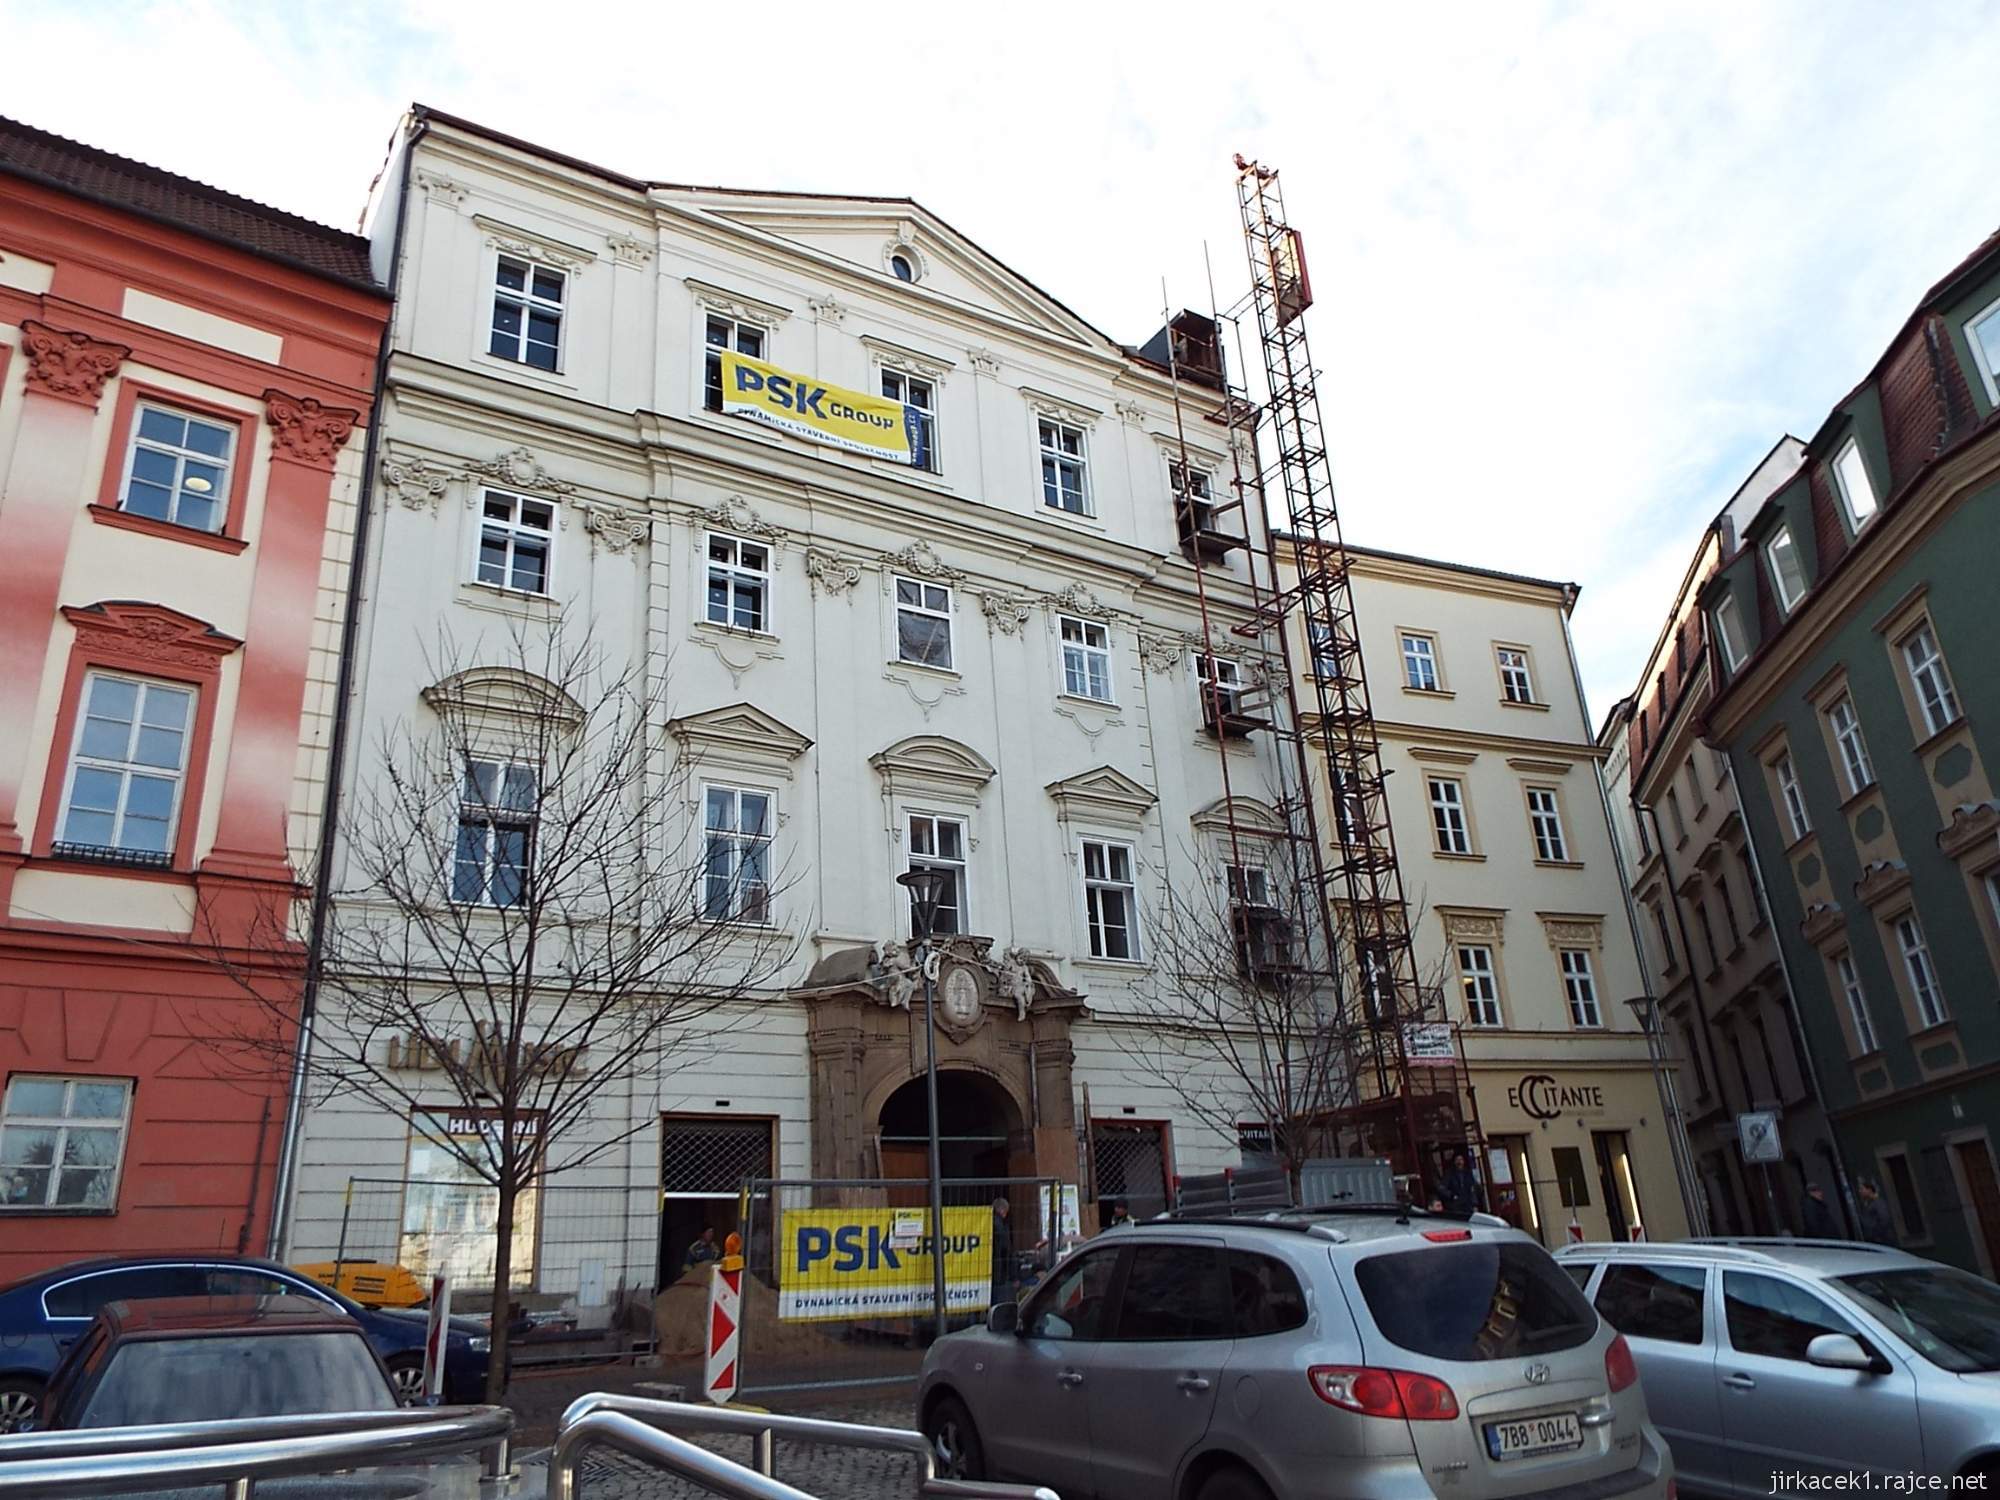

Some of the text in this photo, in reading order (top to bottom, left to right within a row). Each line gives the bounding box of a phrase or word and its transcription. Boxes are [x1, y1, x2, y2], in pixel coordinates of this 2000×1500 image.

[736, 365, 894, 429] PSK GROUP
[1508, 1075, 1604, 1119] ECCITANTE
[797, 1226, 900, 1272] PSK
[795, 1288, 980, 1309] DYNAMICKÁ STAVEBNÍ SPOČNOST
[1538, 1417, 1574, 1443] 0044
